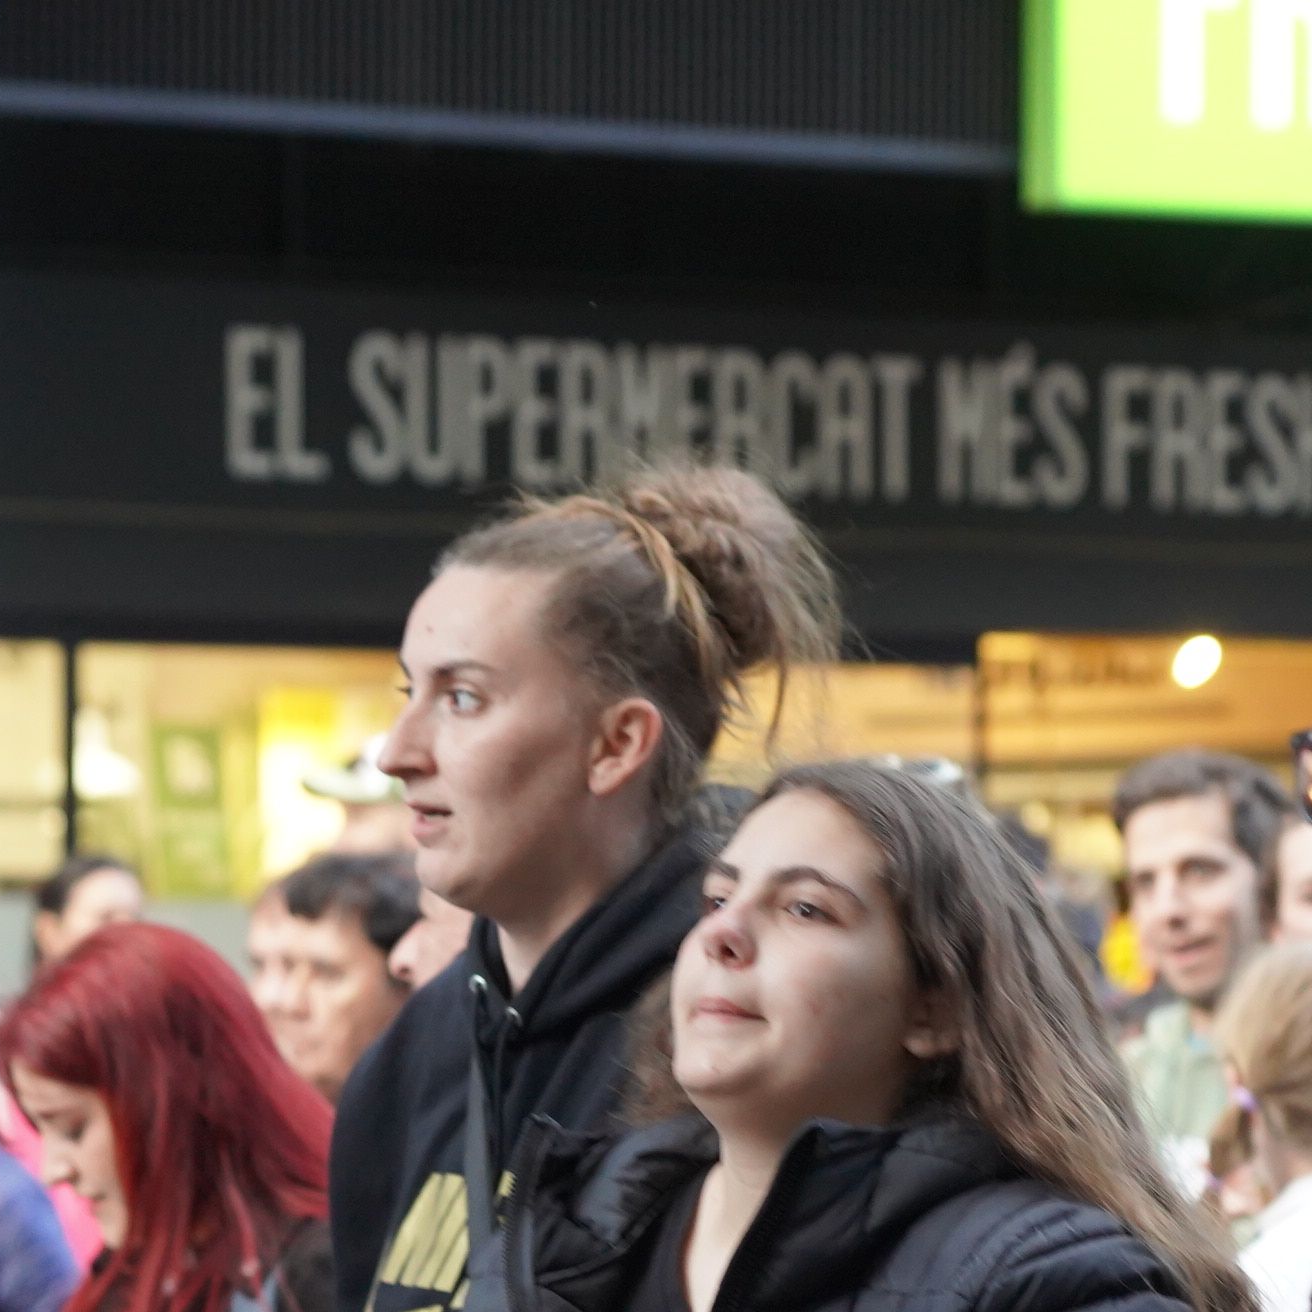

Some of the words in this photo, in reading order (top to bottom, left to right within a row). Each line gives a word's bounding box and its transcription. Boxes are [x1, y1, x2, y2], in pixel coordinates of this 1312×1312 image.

[223, 325, 330, 482] EL
[347, 330, 923, 505] SUPERMERCAT
[938, 340, 1088, 507] MÉS
